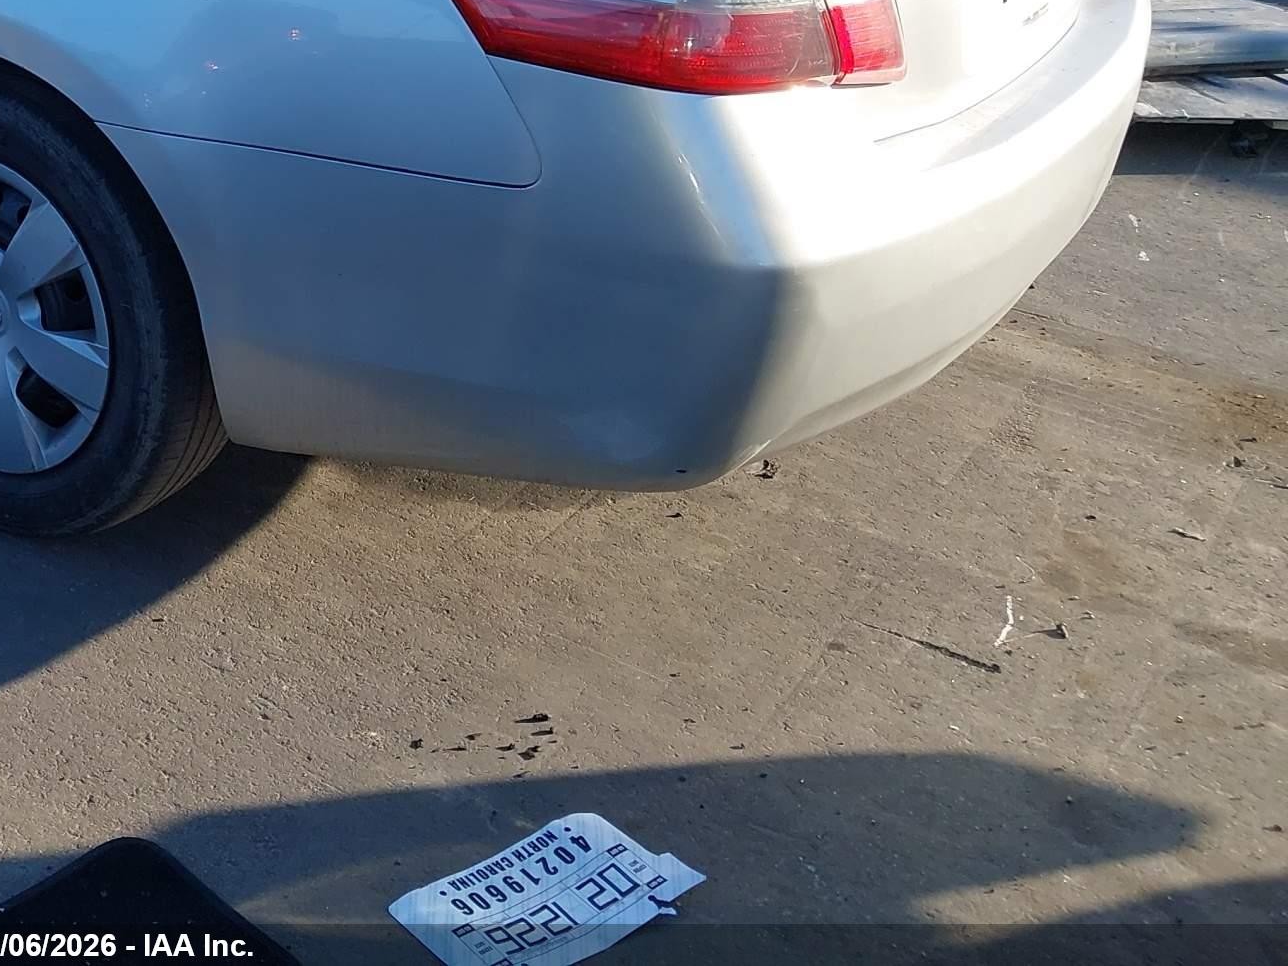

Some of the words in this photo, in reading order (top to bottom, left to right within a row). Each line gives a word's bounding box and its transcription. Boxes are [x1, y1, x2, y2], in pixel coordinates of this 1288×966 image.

[512, 830, 559, 862] NORTH
[447, 856, 513, 891] CAROLINA
[450, 835, 592, 915] 40219606
